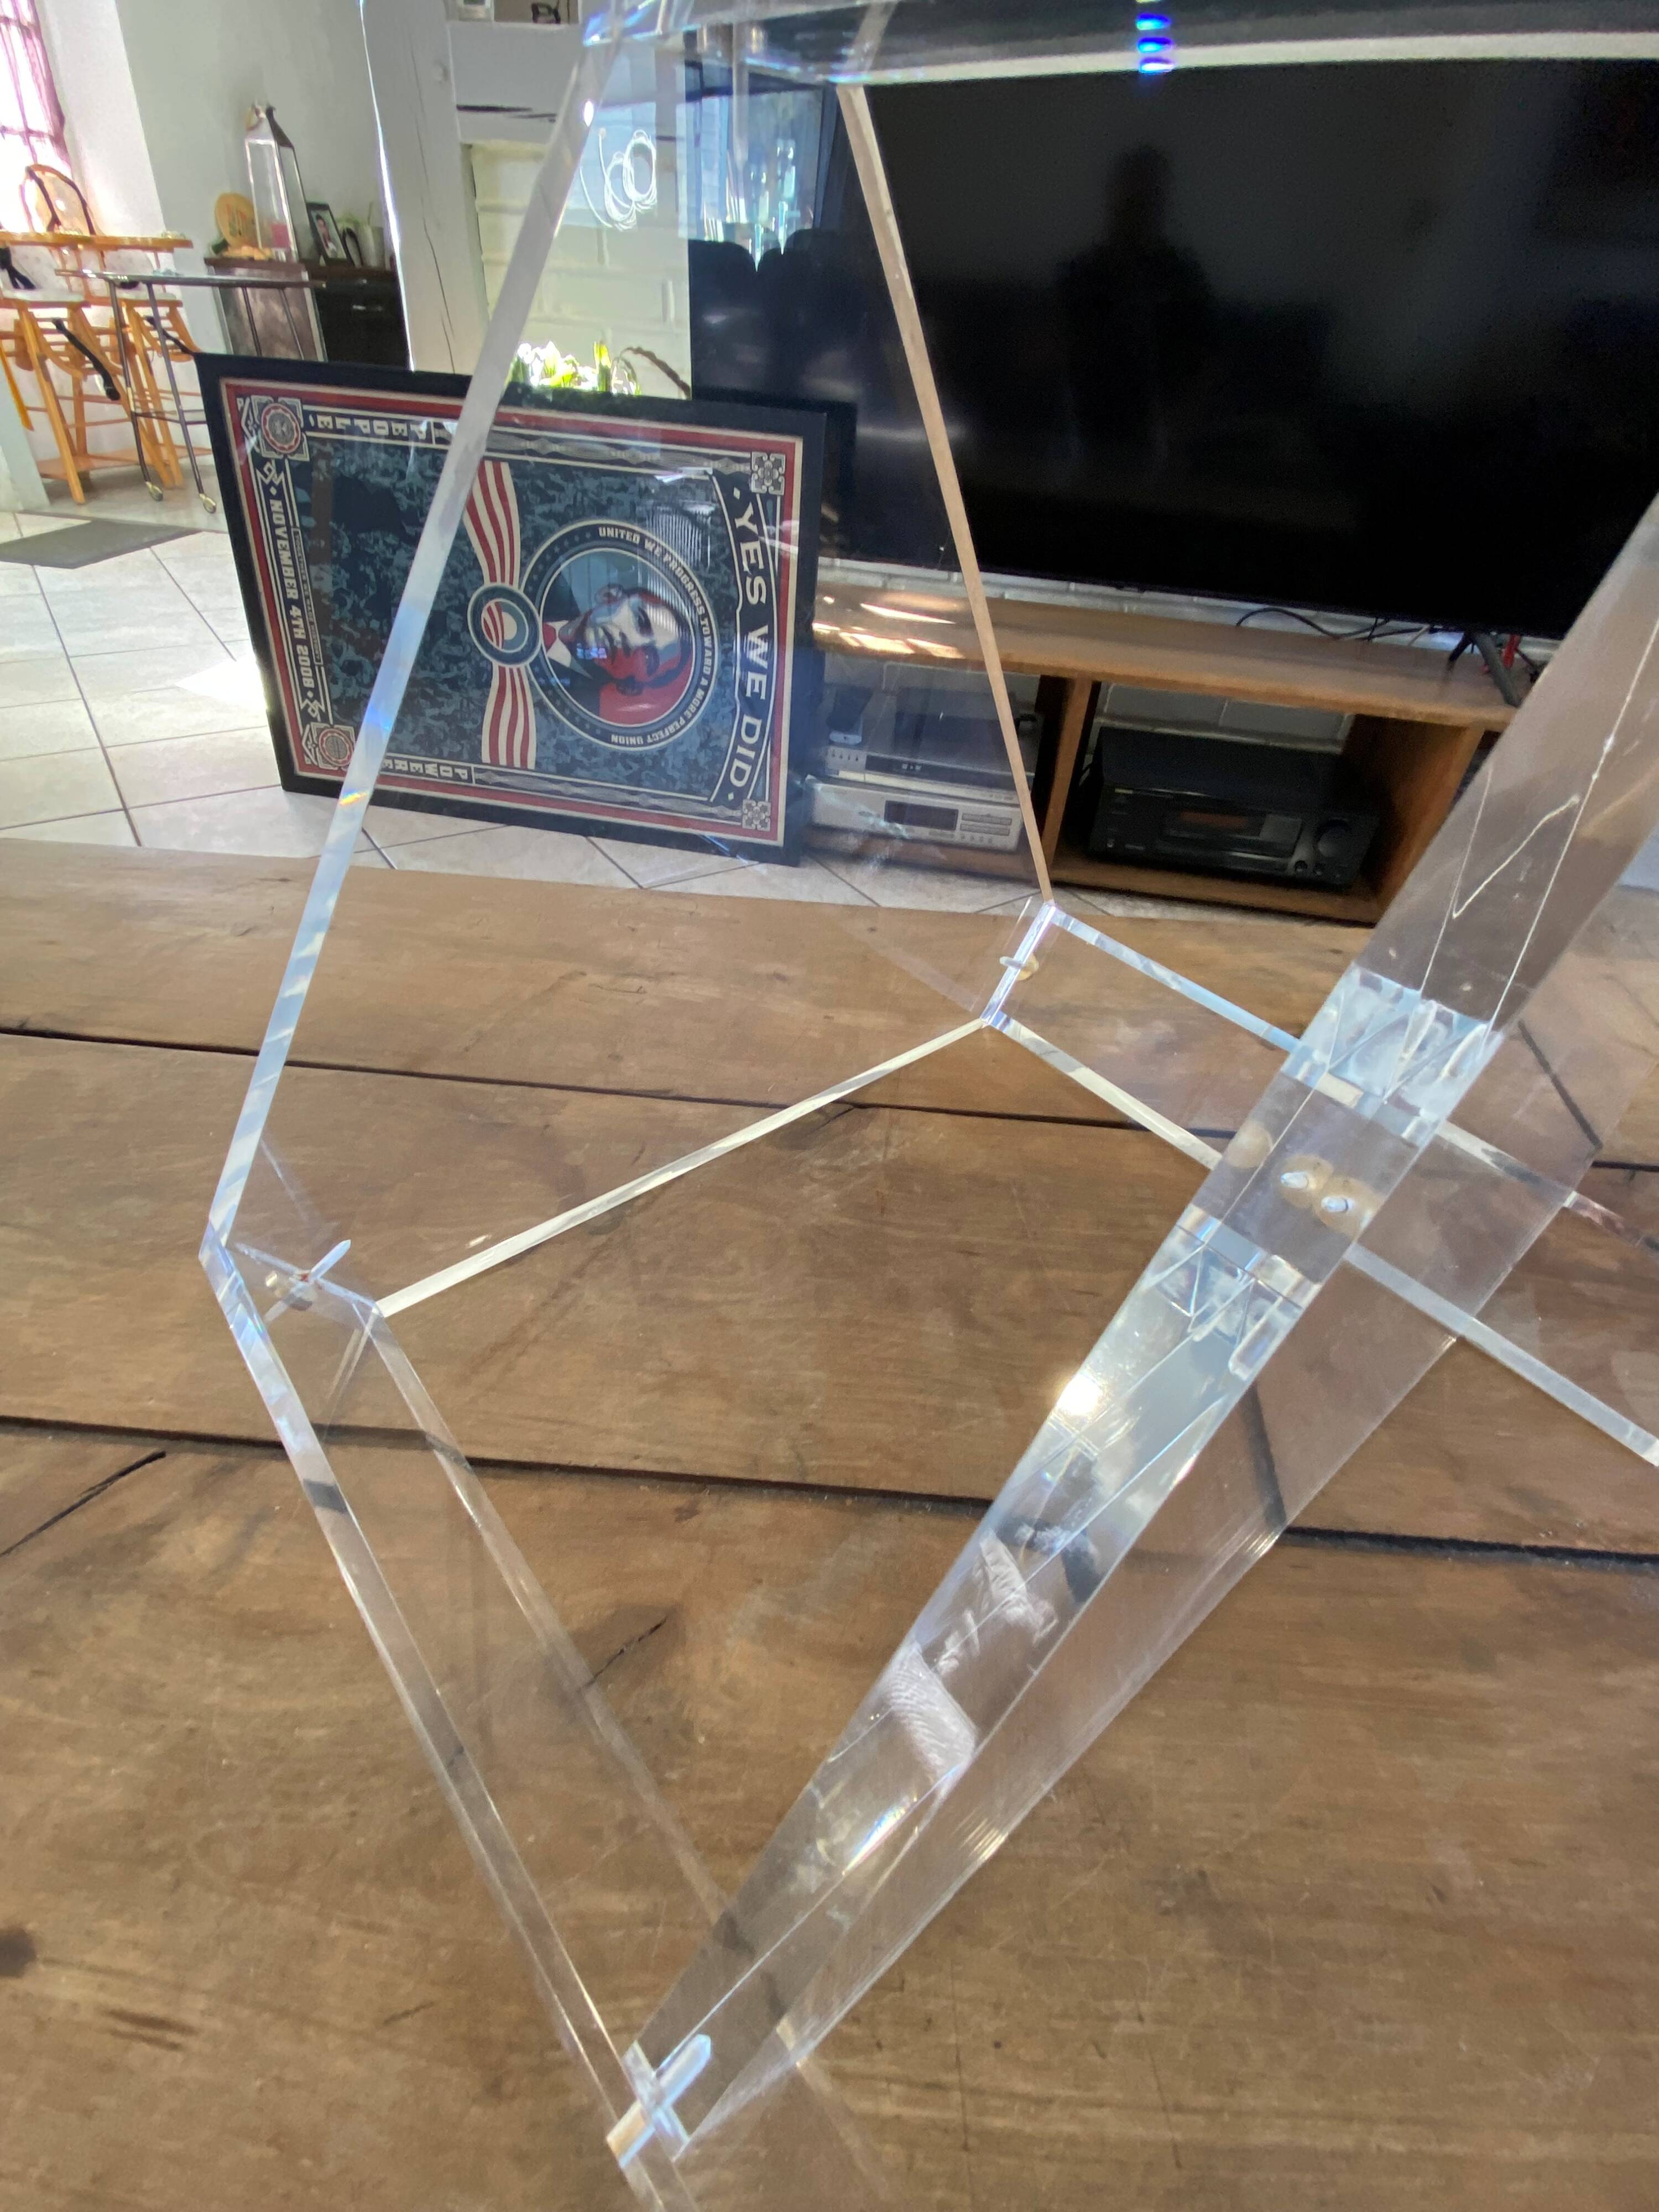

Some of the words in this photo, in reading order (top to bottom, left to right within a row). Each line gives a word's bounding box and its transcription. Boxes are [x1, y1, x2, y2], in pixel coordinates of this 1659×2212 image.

[269, 499, 299, 599] NOVEMBER
[598, 526, 640, 544] UNITED
[644, 539, 662, 557] WE
[735, 503, 766, 604] YES
[664, 553, 705, 615] PROGRESS
[289, 606, 306, 640] 4TH
[700, 618, 712, 675] TOWARD
[743, 624, 768, 701] WE
[297, 646, 315, 688] 2008
[700, 677, 708, 686] A
[684, 689, 705, 718] MORE
[611, 734, 644, 745] UNION
[647, 716, 686, 743] PERFECT
[383, 759, 468, 780] POWERE
[729, 718, 762, 787] DID
